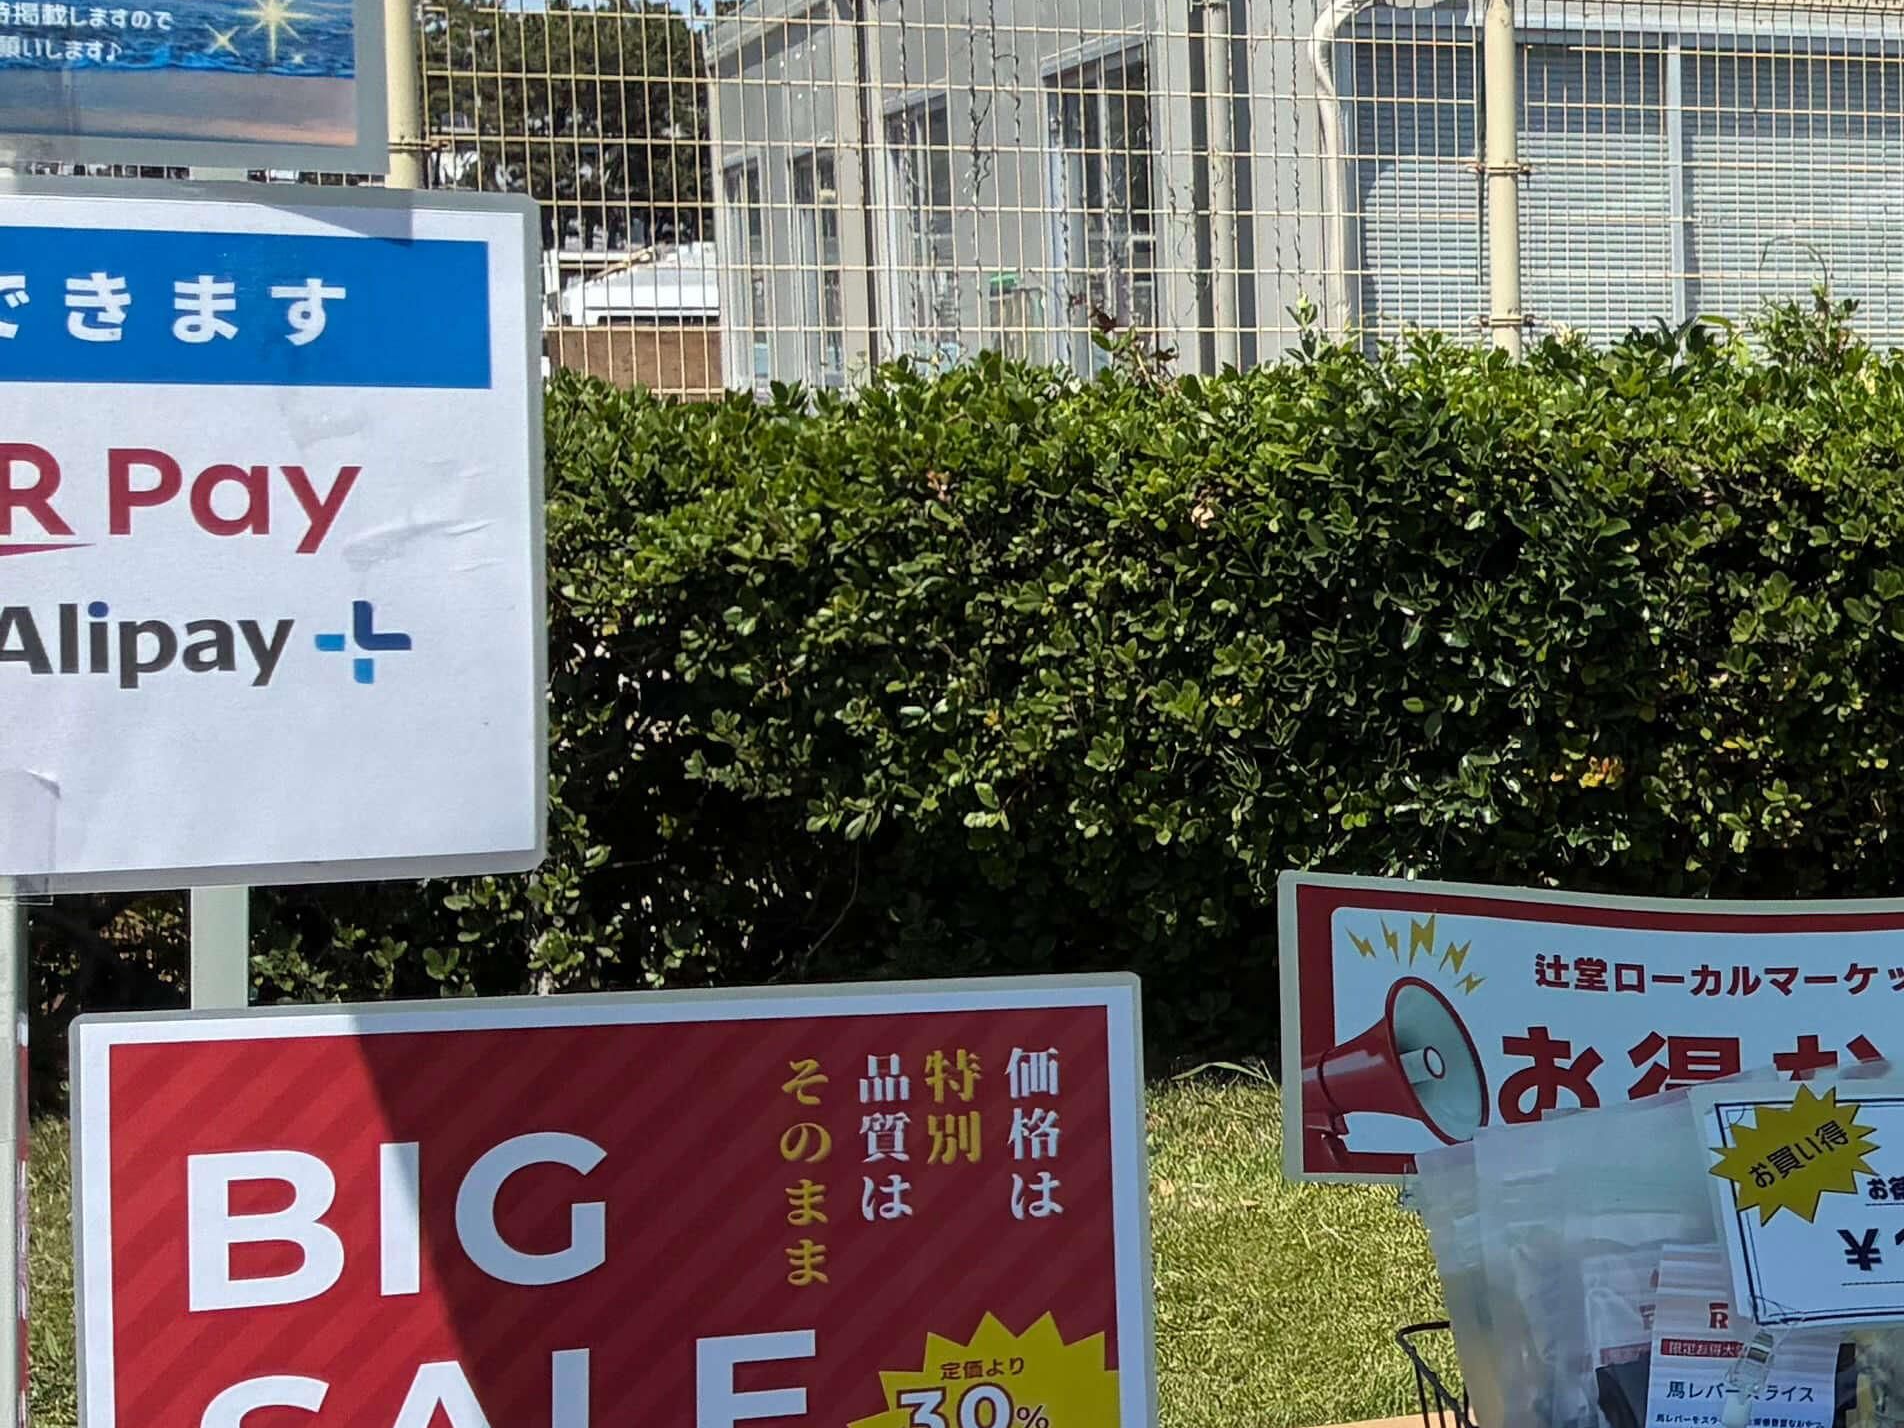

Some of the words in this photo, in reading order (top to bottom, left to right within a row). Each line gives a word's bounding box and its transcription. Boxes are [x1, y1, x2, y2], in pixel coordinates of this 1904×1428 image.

[108, 447, 362, 554] Pay
[0, 601, 294, 690] Alipay
[859, 1053, 913, 1221] 品質は
[924, 1049, 983, 1164] 特別
[1005, 1047, 1064, 1220] 価格は
[1748, 1119, 1850, 1189] お買い得
[187, 1131, 608, 1312] BIG
[780, 1059, 832, 1286] そのまま
[940, 1357, 1024, 1380] 定価より
